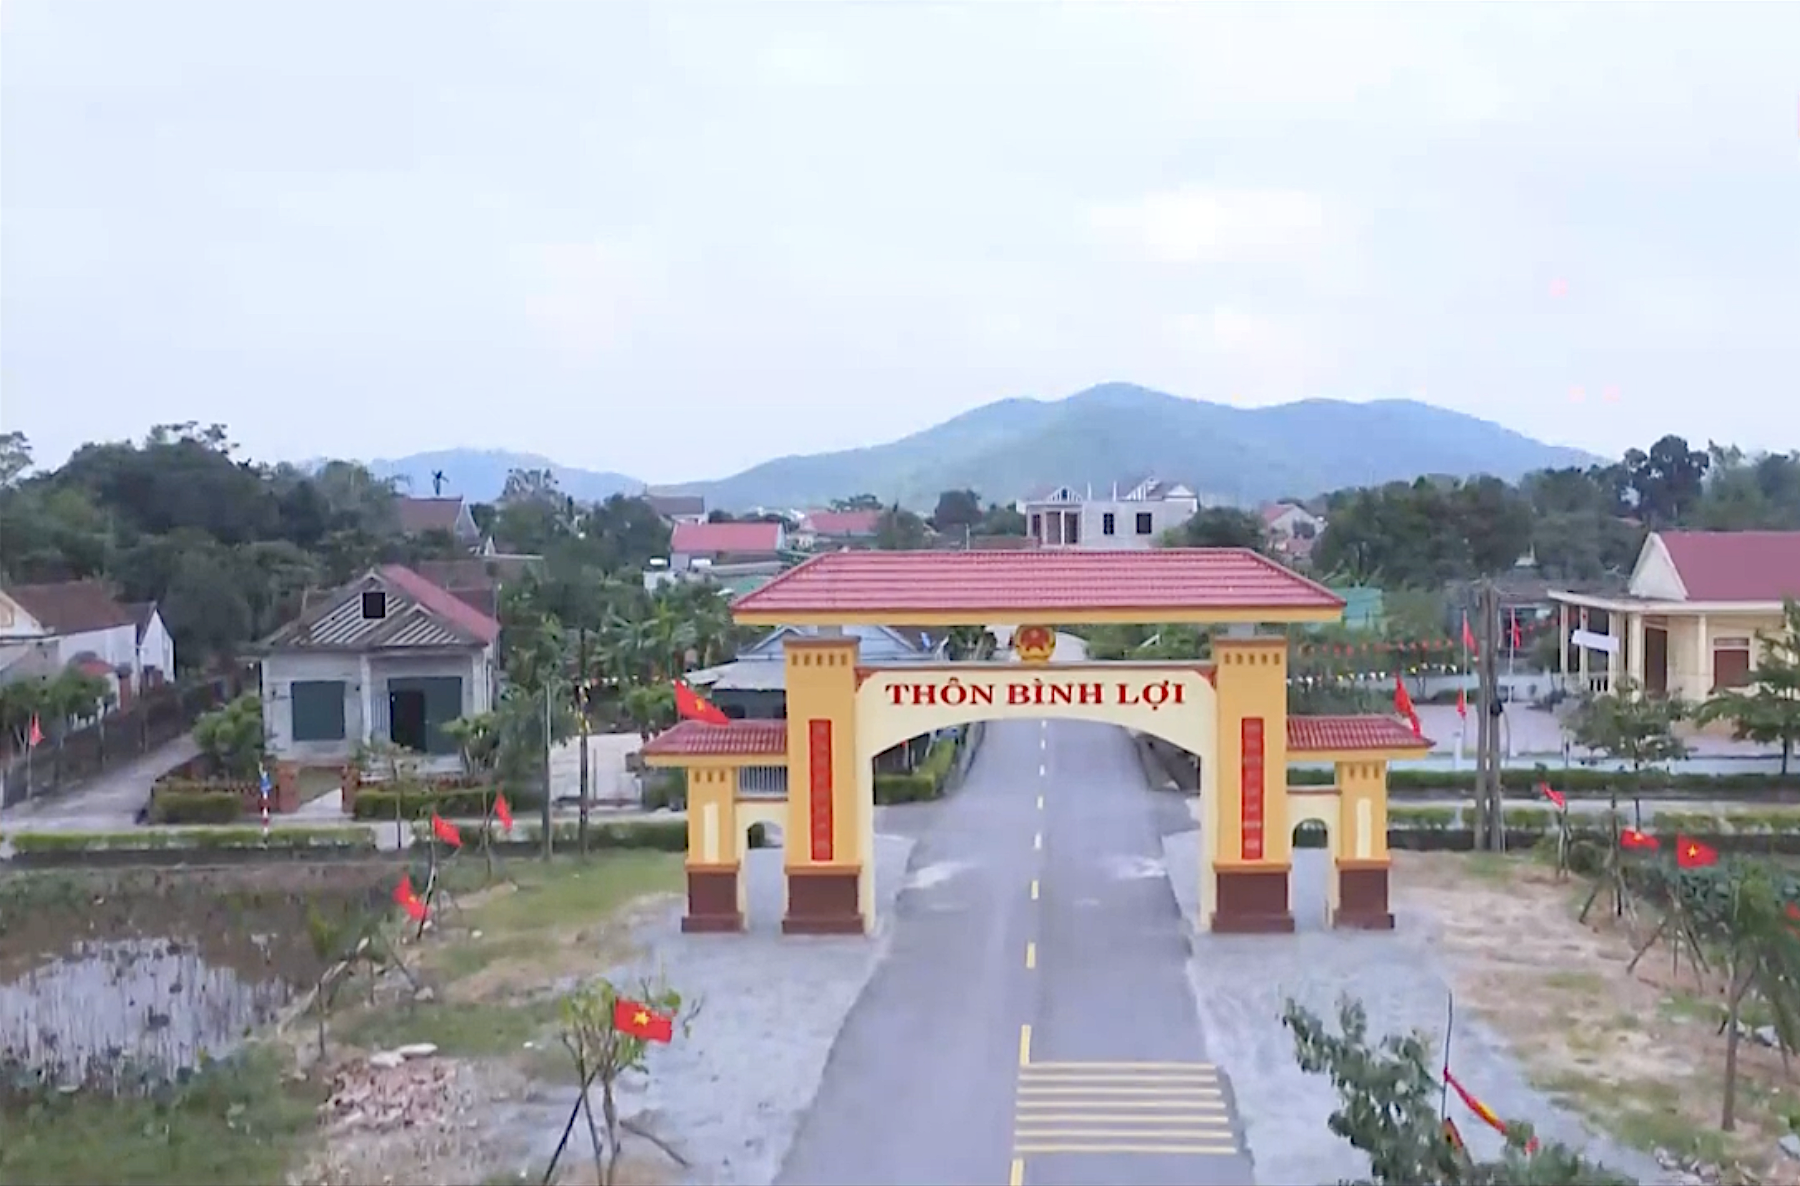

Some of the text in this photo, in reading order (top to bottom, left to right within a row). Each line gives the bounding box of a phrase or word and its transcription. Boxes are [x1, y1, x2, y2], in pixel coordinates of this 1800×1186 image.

[885, 677, 1185, 711] THÔN BÌNH LỢI
